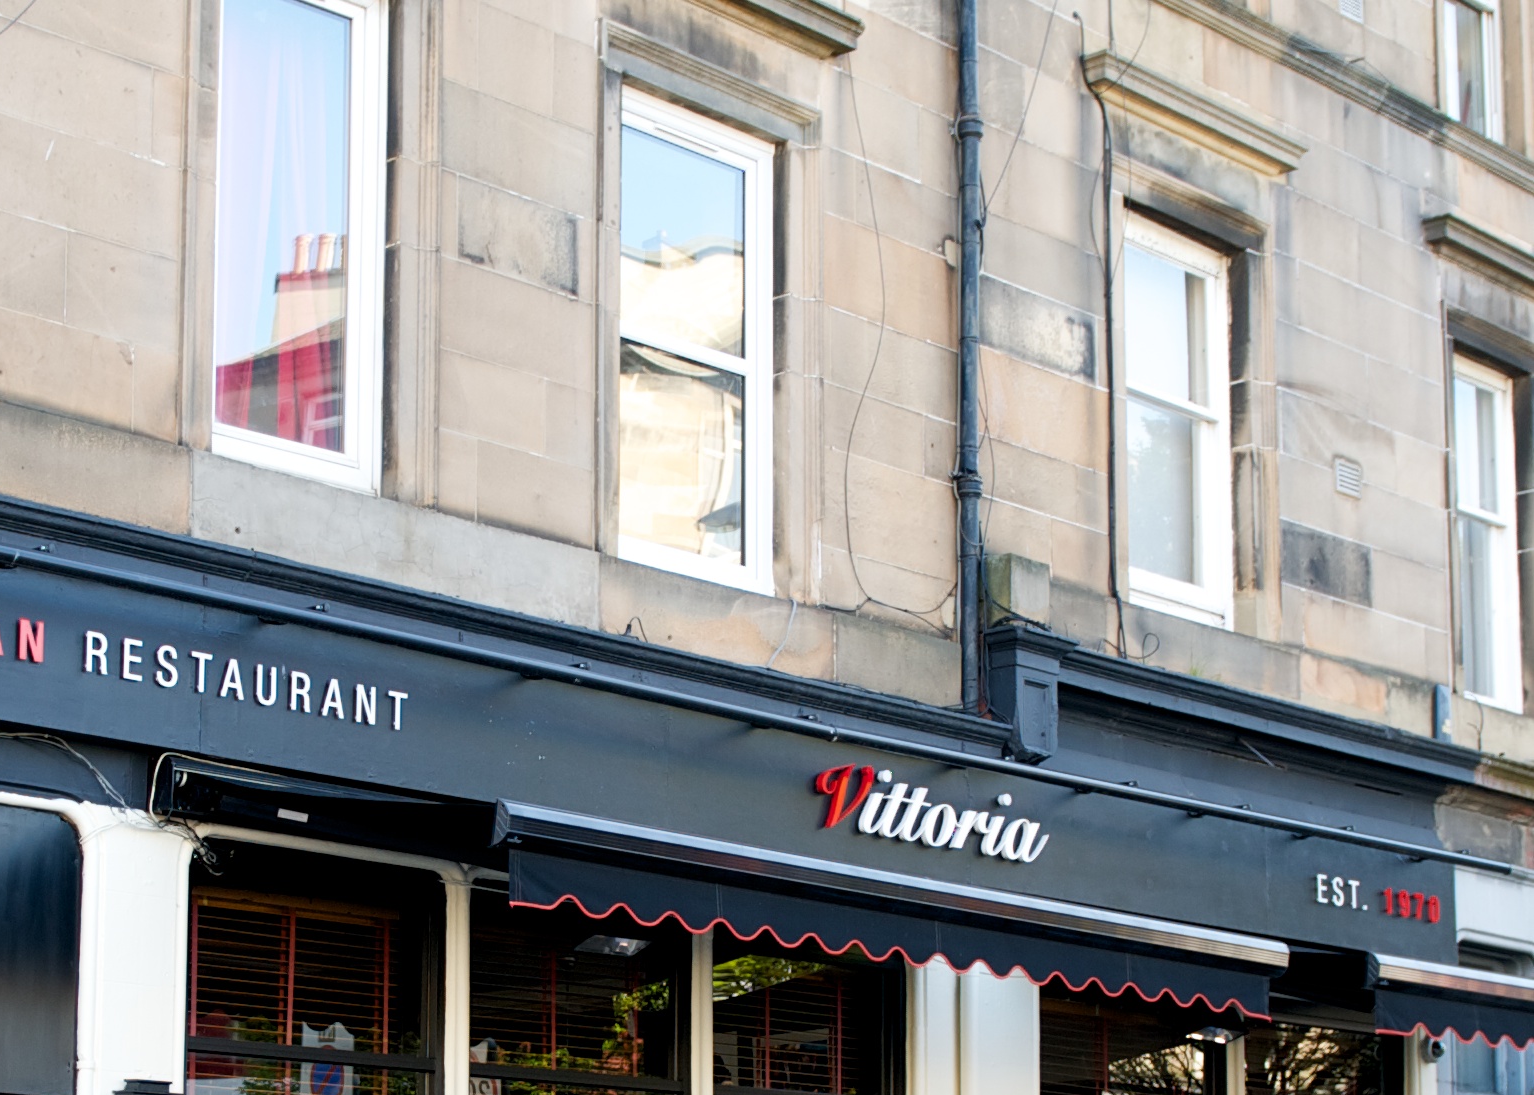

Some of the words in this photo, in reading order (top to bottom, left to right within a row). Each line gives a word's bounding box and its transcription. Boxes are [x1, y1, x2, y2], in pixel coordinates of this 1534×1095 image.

[83, 630, 409, 731] RESTAURANT
[815, 762, 1049, 864] Vittoria
[1315, 873, 1369, 911] EST.
[1382, 886, 1441, 924] 1970
